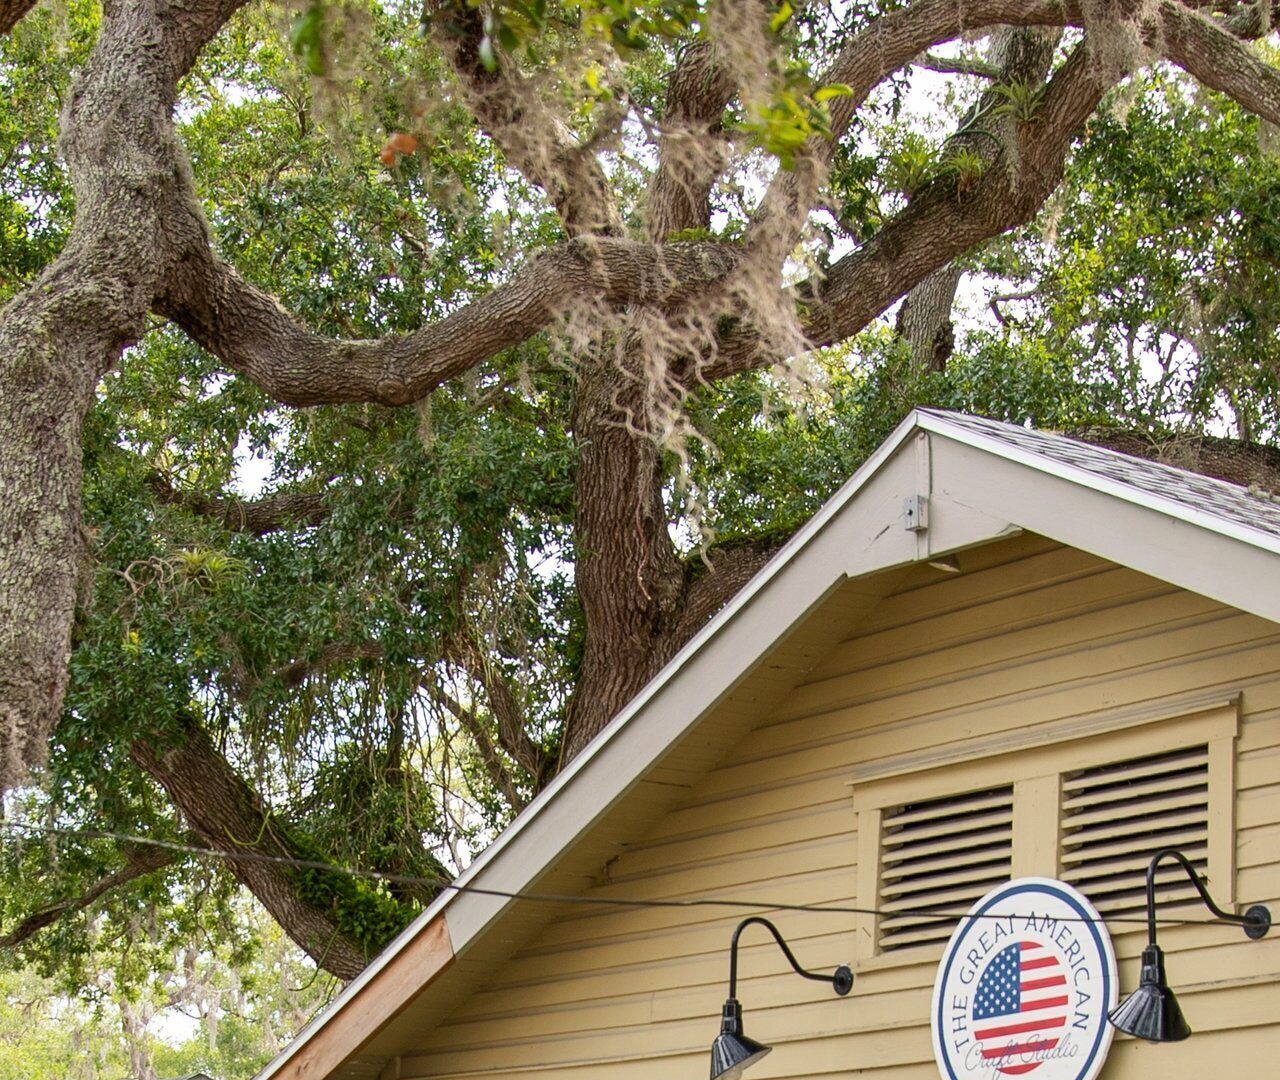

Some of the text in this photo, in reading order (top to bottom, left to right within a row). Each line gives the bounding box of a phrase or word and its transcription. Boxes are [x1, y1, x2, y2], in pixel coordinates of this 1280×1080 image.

[952, 911, 1090, 1054] THE GREAT AMERICAN
[1020, 1033, 1079, 1063] Studio
